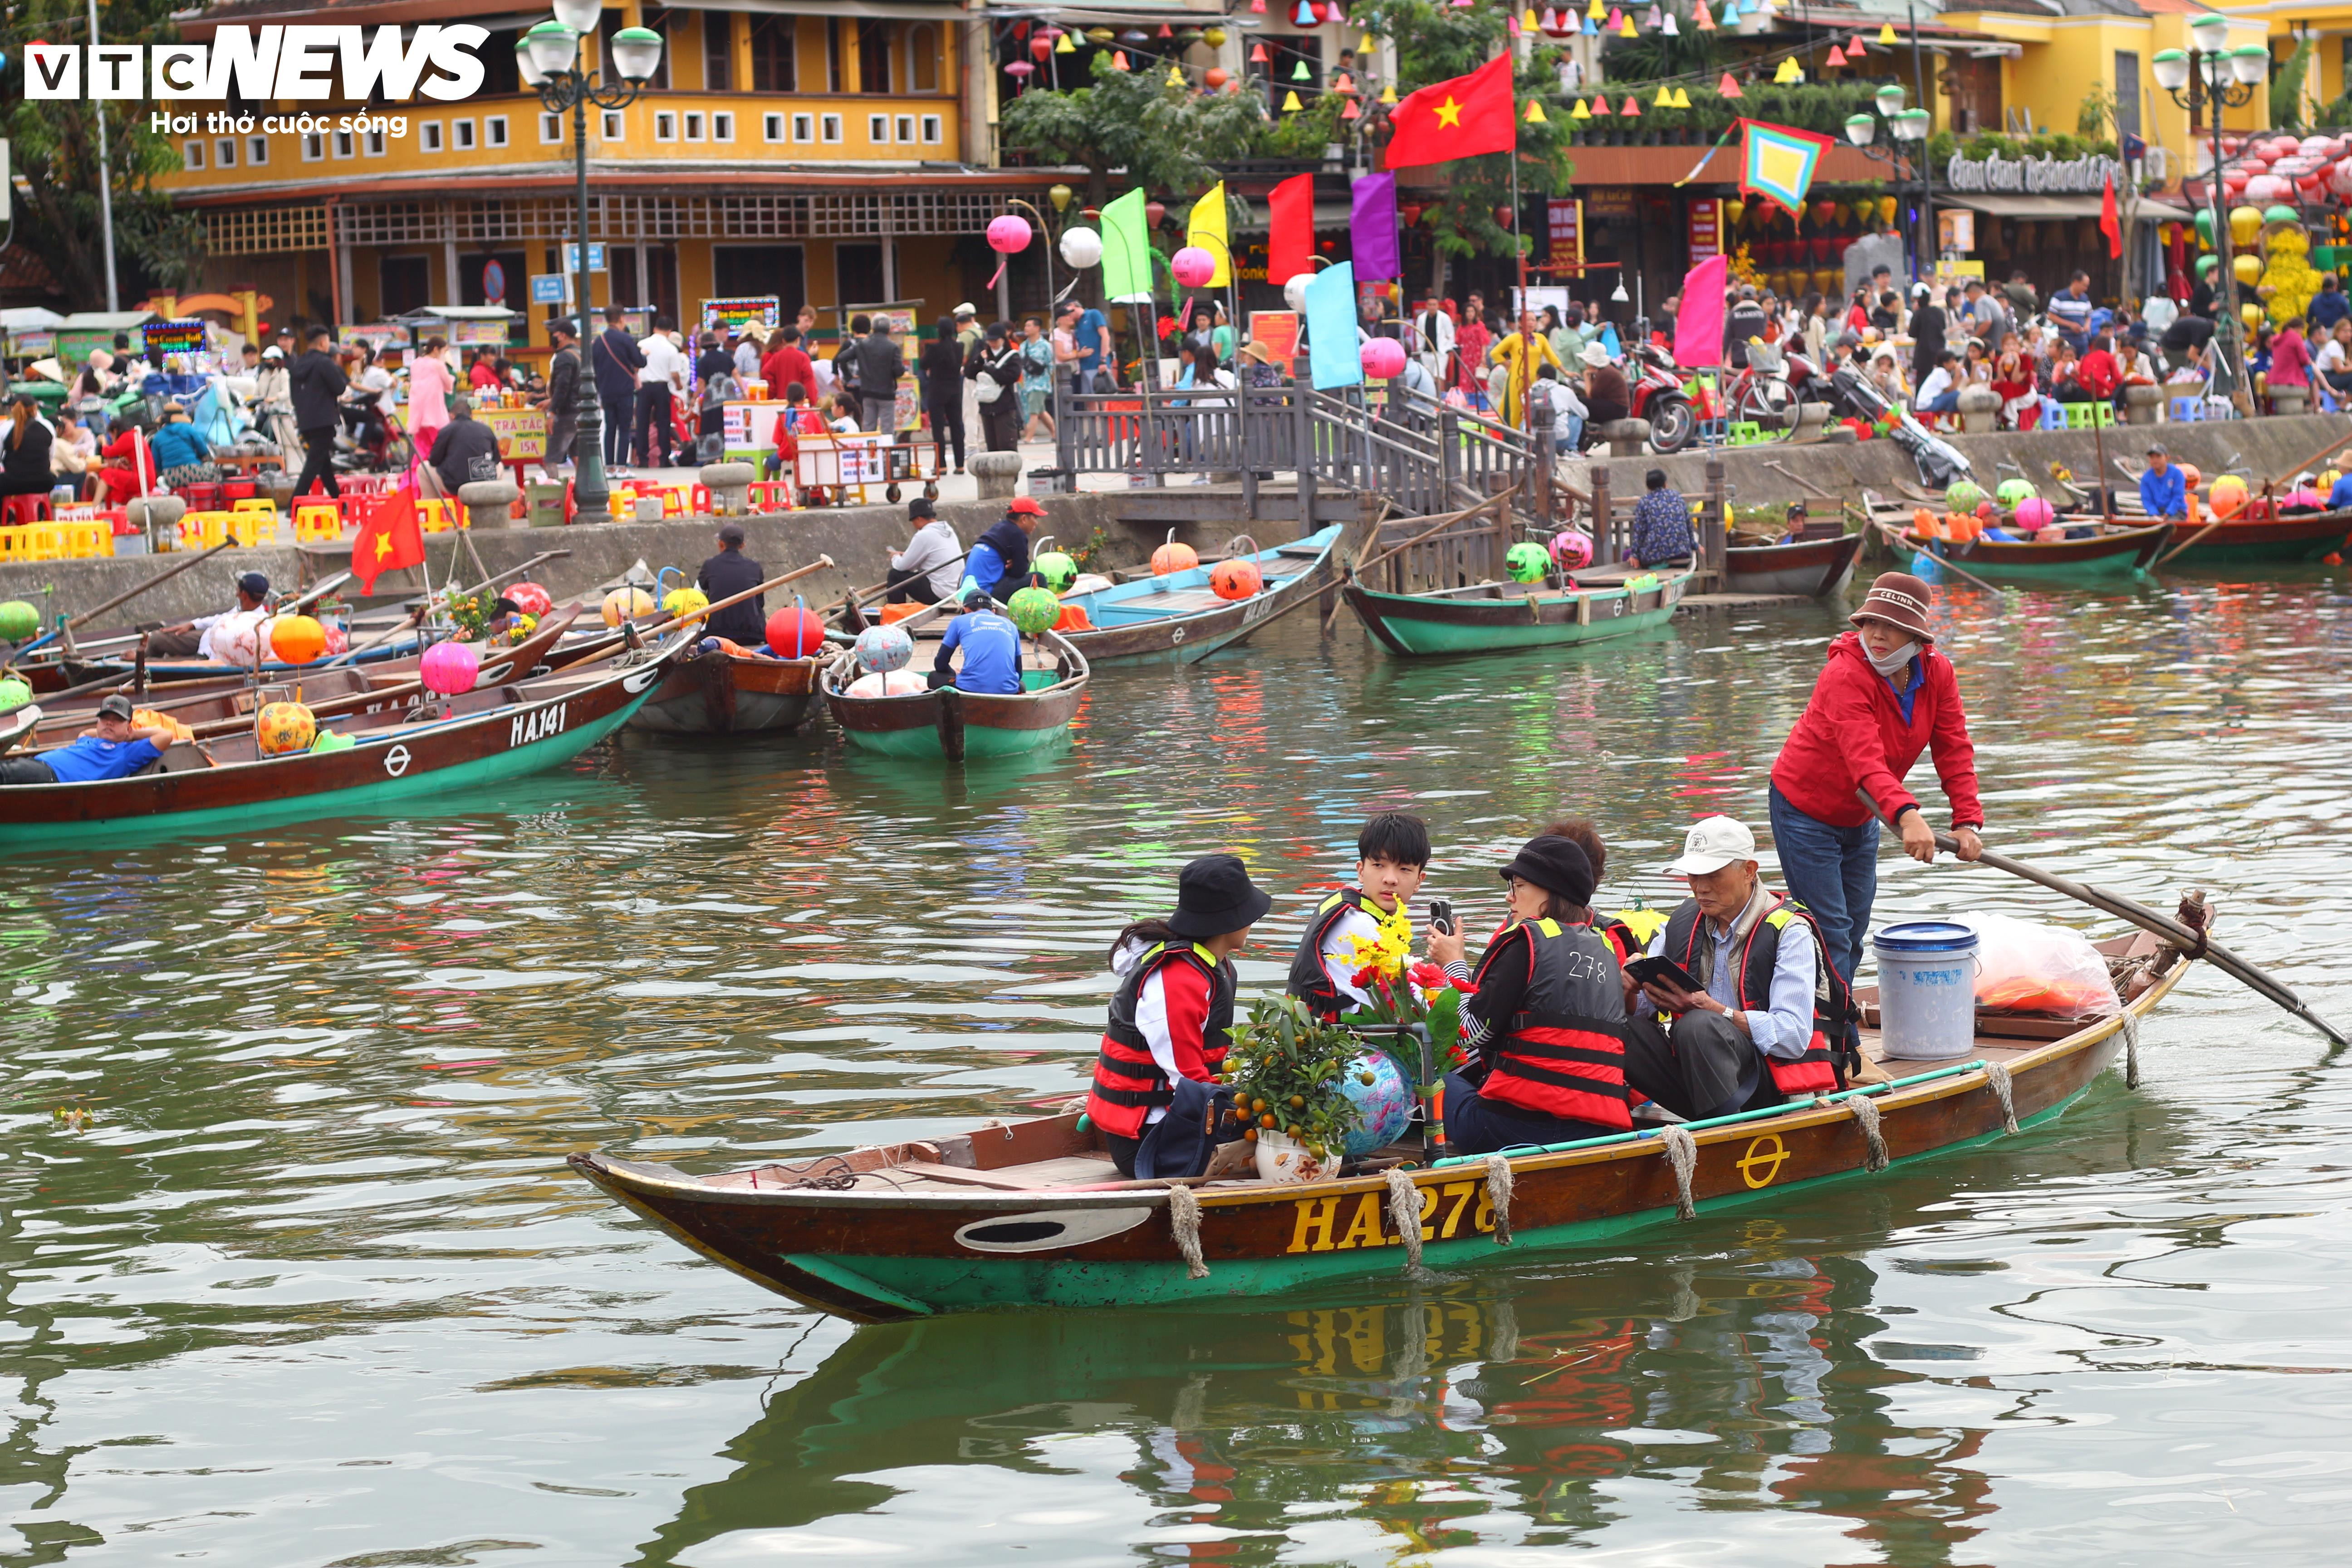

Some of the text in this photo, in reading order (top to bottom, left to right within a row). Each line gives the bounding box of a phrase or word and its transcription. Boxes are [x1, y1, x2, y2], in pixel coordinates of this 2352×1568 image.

[1880, 591, 1913, 606] CELINN
[510, 702, 566, 748] HA.141
[1568, 951, 1607, 984] 278
